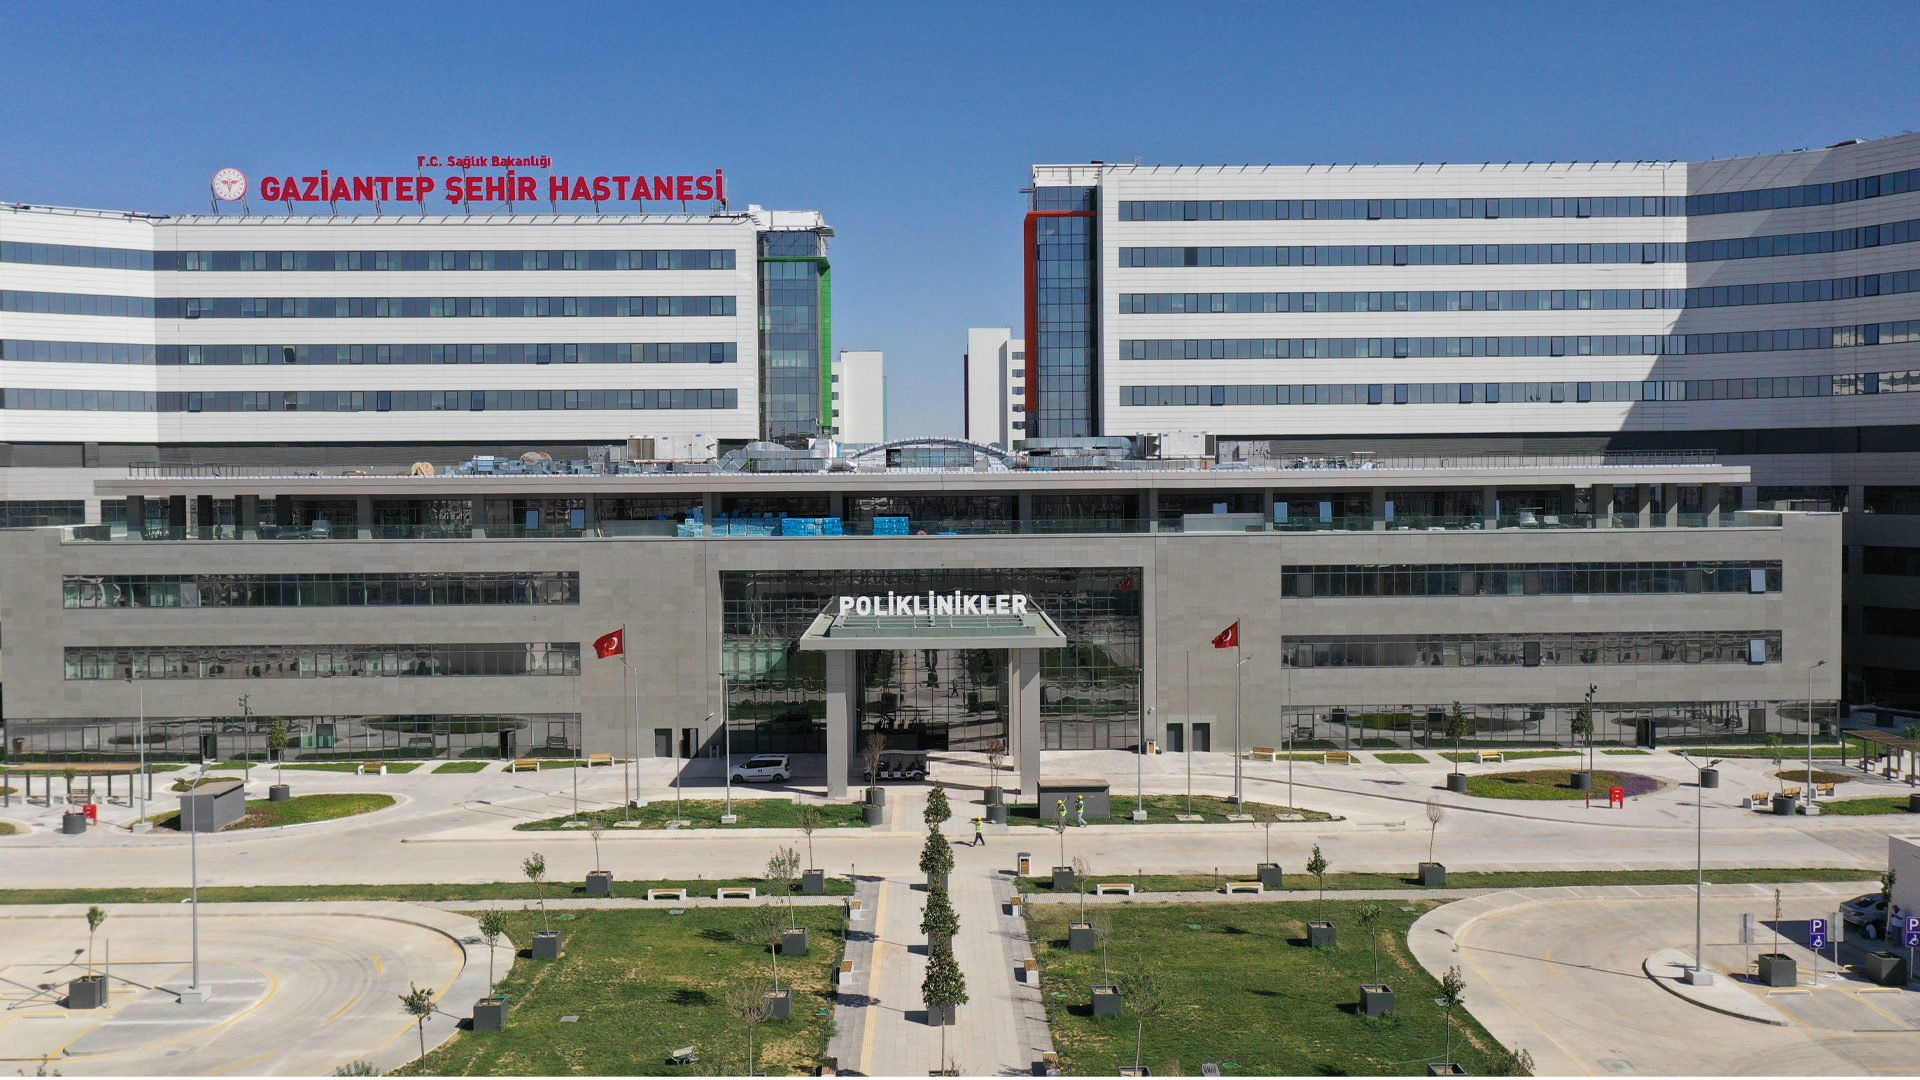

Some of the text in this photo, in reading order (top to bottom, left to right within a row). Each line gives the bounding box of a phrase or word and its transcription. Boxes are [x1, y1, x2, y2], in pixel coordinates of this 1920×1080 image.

[417, 155, 552, 169] T.C. Sağlık Bakanlığı
[261, 168, 724, 205] GAZİANTEP ŞEHİR HASTANESİ
[839, 590, 1029, 616] POLİKLİNİKLER
[1813, 920, 1822, 932] P
[1909, 918, 1919, 931] P
